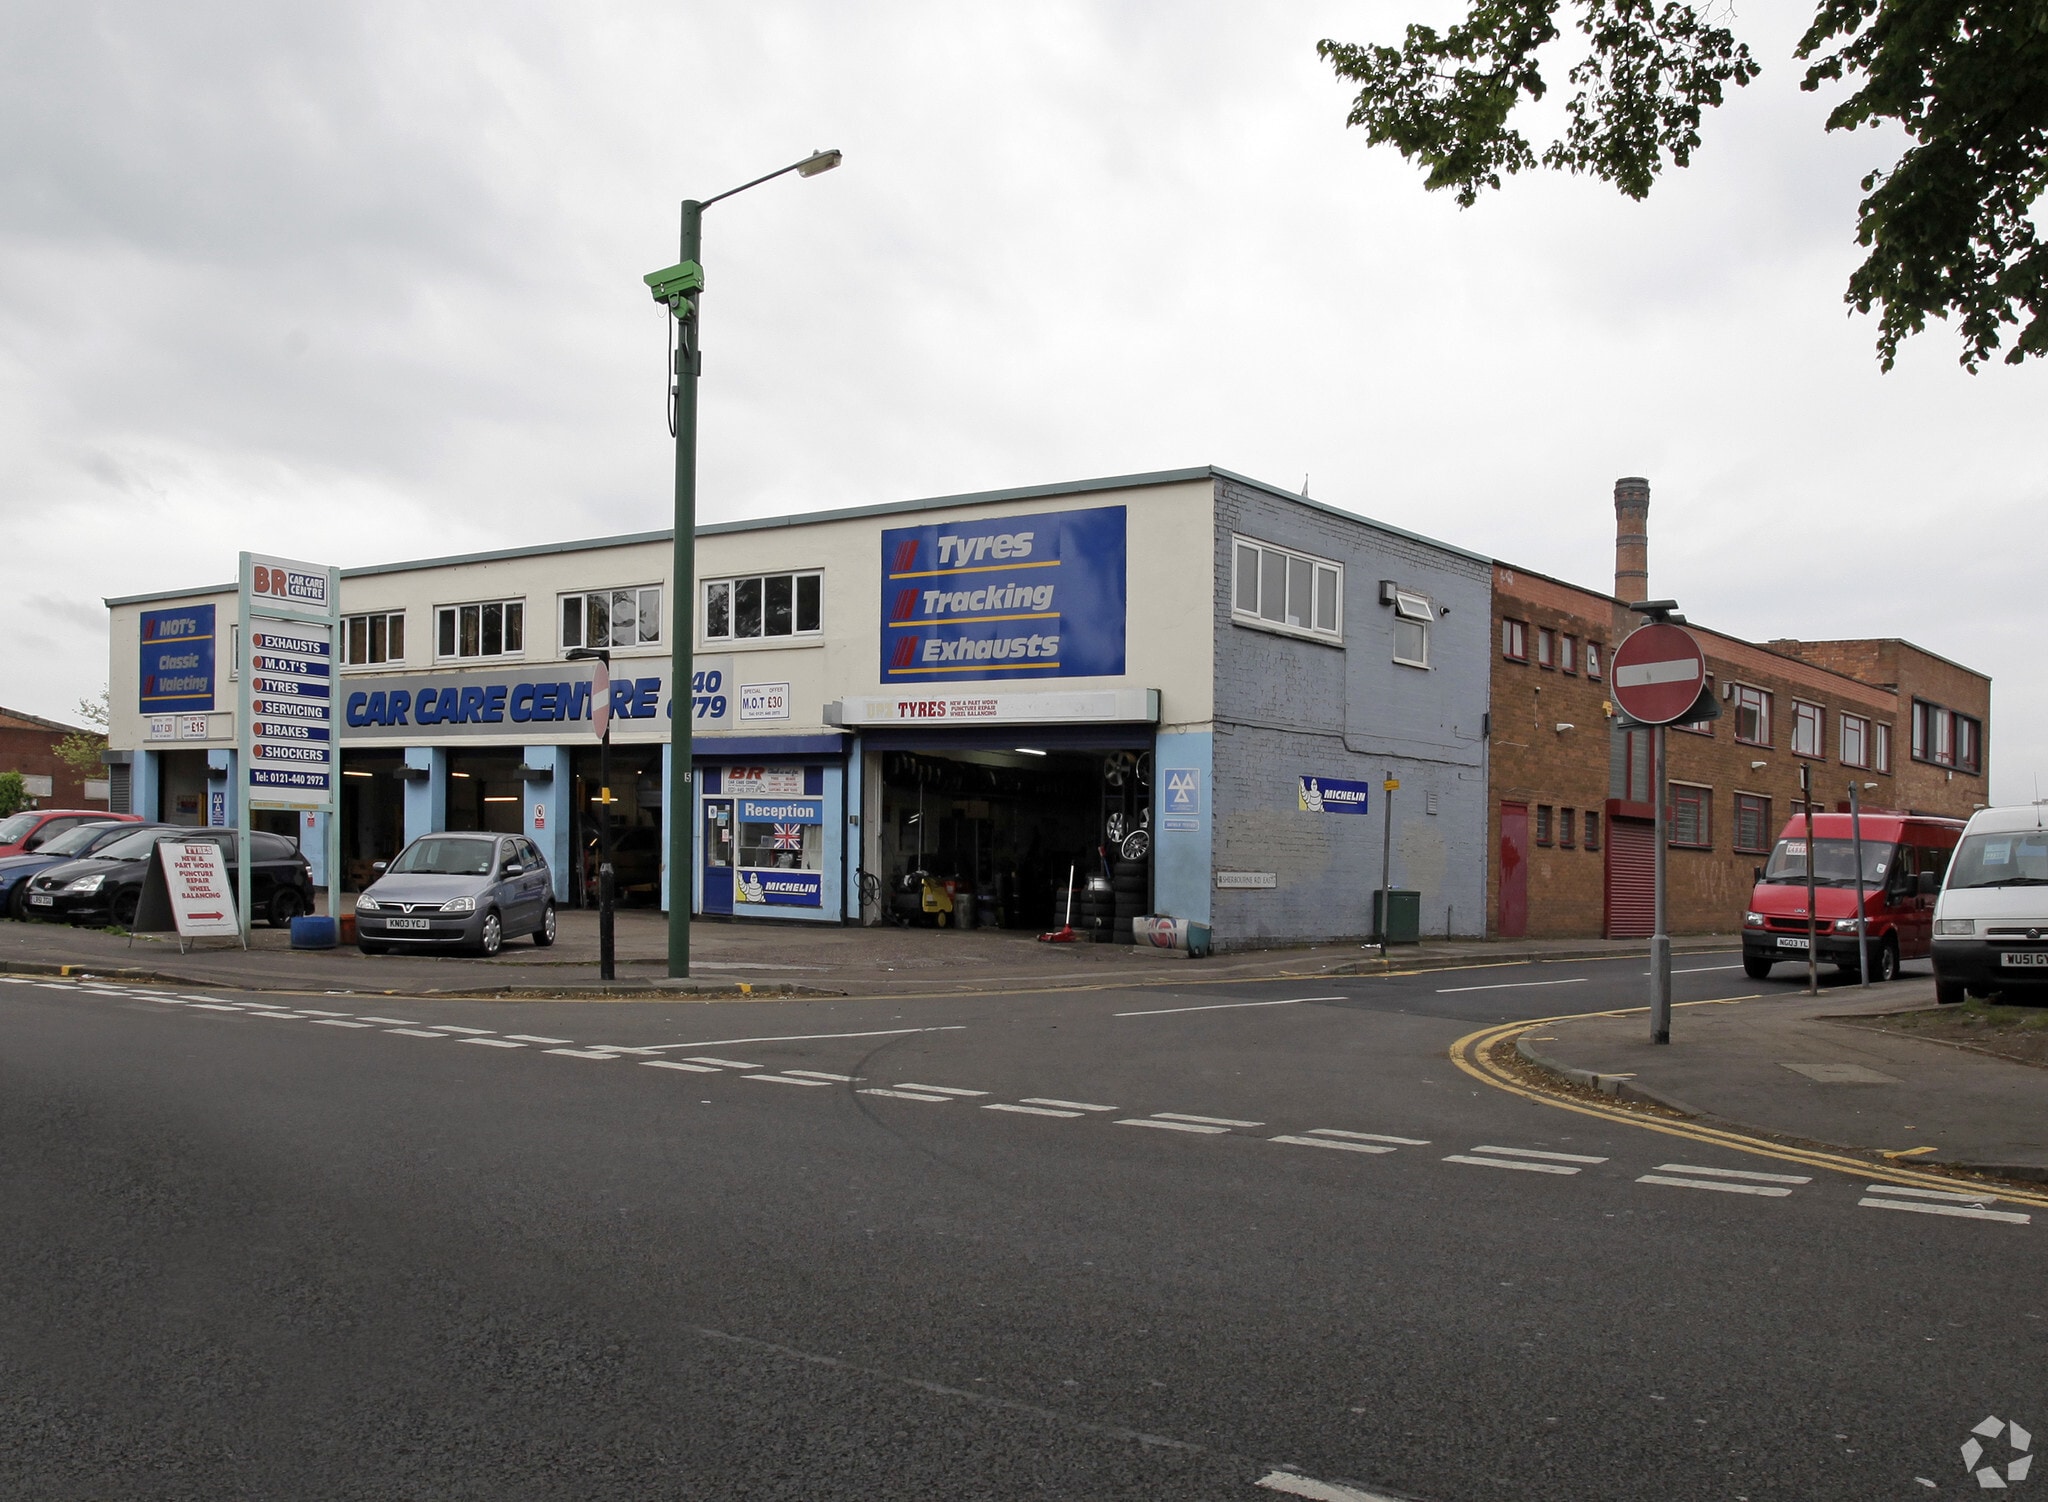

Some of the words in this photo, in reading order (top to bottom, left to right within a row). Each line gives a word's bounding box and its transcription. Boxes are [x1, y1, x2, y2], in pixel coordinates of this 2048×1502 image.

[937, 532, 1034, 567] Tyres
[254, 566, 287, 597] BR
[289, 574, 304, 586] CAR
[305, 577, 324, 589] CARE
[290, 586, 323, 599] CENTRE
[922, 583, 1055, 614] Tracking
[160, 618, 196, 636] MOT's
[264, 635, 321, 653] EXHAUSTS
[921, 633, 1061, 662] Exhausts
[159, 652, 199, 670] Classic
[264, 658, 308, 673] M.O.T'S
[159, 675, 208, 692] Valeting
[264, 680, 299, 693] TYRES
[264, 701, 323, 718] SERVICING
[346, 691, 411, 727] CAR
[414, 685, 508, 725] CARE
[742, 696, 765, 710] M.O.T
[767, 695, 783, 709] £30
[897, 700, 946, 718] TYRES
[191, 721, 205, 733] £15
[264, 724, 309, 738] BRAKES
[264, 746, 324, 761] SHOCKERS
[255, 771, 269, 782] Tel:
[270, 772, 306, 785] 0121-440
[728, 766, 765, 780] BR
[1323, 789, 1366, 802] MICHELIN
[745, 802, 814, 820] Reception
[187, 846, 212, 854] TYRES
[765, 881, 818, 893] MICHELIN
[389, 919, 410, 928] KN03
[411, 920, 426, 929] YCJ
[2007, 954, 2033, 965] WU51
